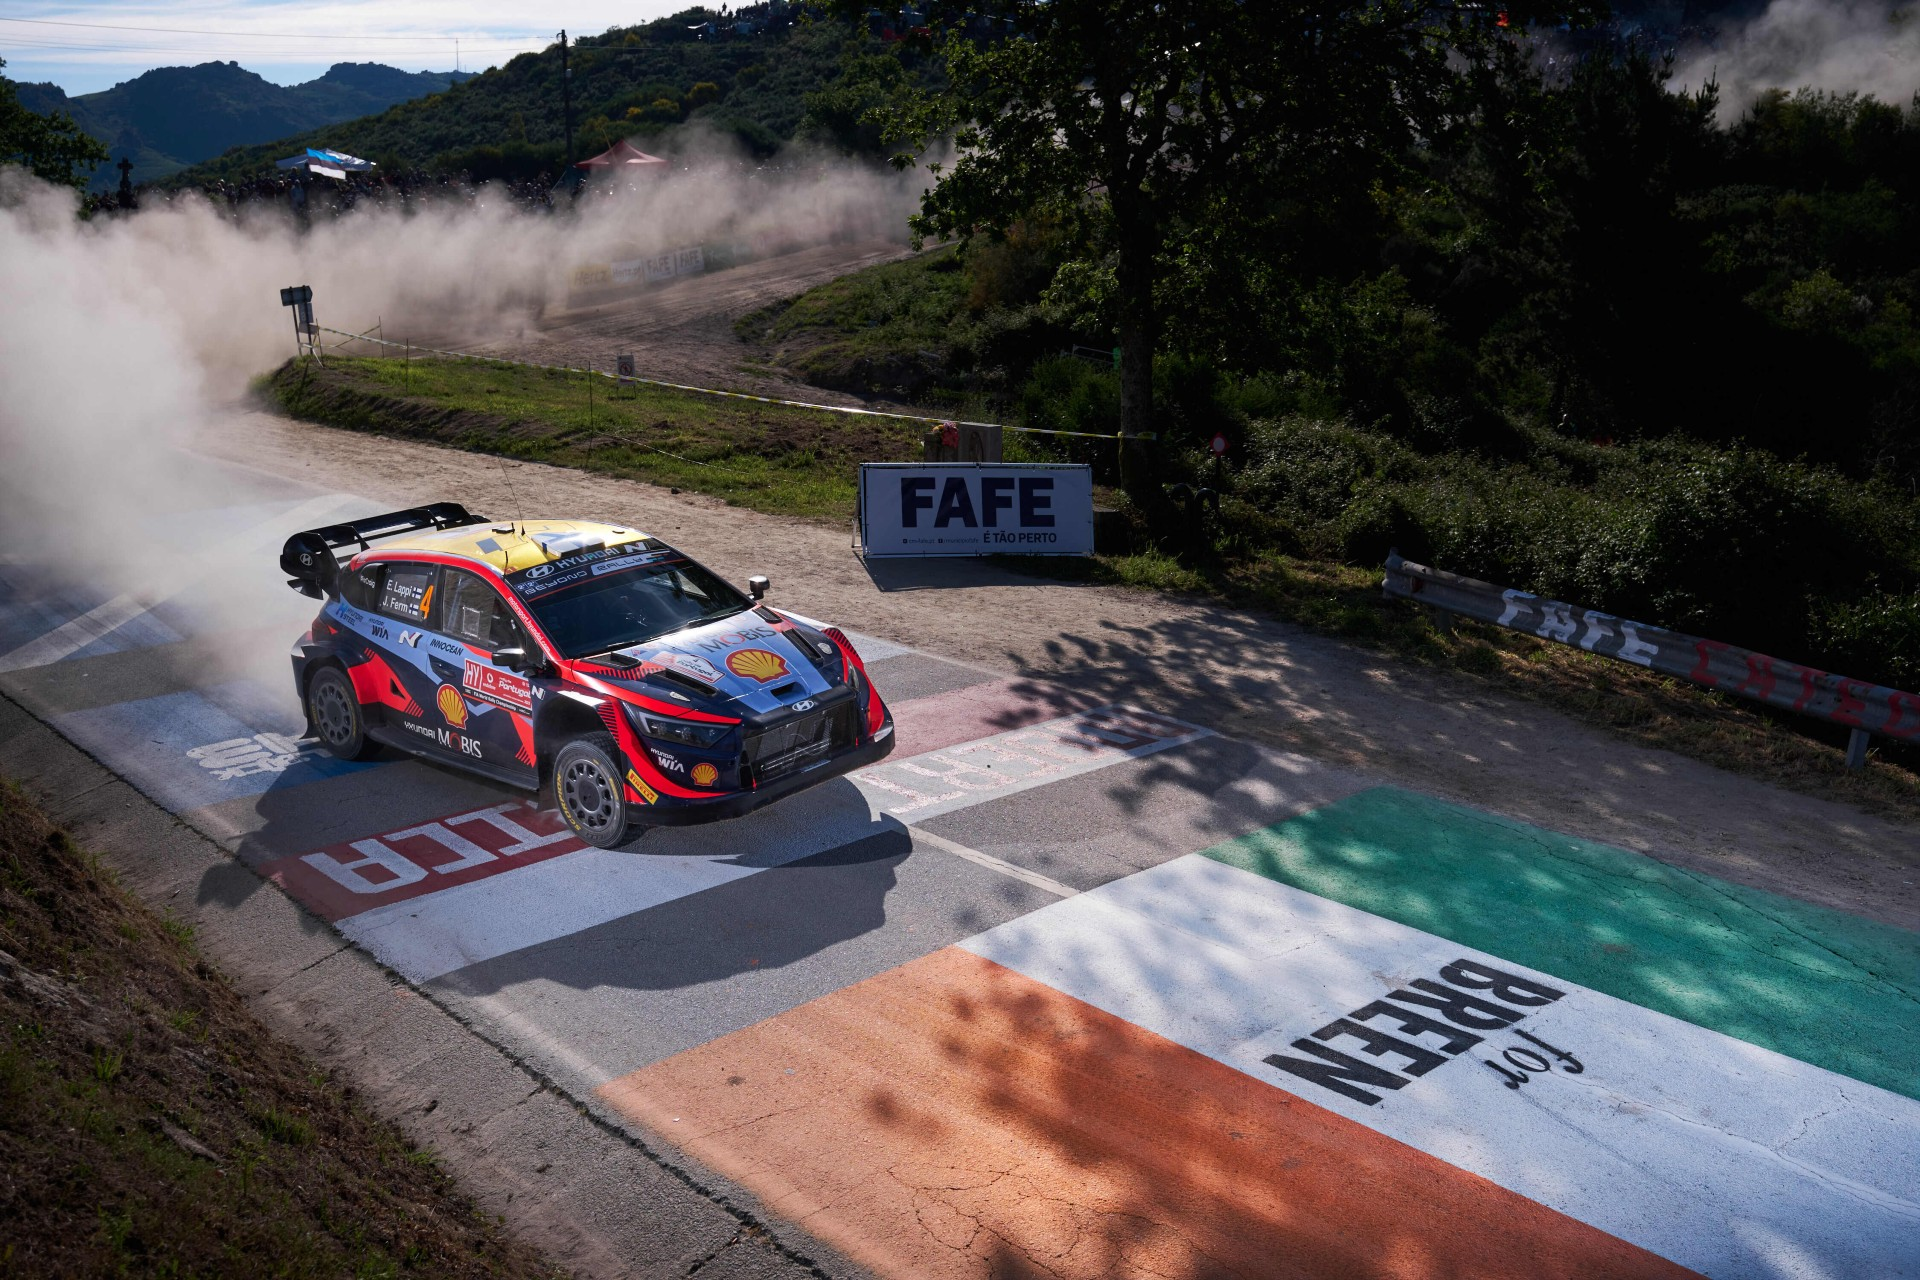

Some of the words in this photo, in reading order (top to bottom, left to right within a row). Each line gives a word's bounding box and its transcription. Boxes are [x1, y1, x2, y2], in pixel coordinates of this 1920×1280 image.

[901, 477, 1055, 528] FAFE
[983, 530, 991, 543] É
[993, 530, 1016, 543] TÃO
[1018, 532, 1057, 543] PERTO
[556, 547, 620, 569] HYUNDAI
[525, 570, 588, 595] BEYOND
[597, 557, 643, 572] RALLY
[386, 579, 393, 591] E.
[394, 581, 412, 598] Lappi
[382, 595, 389, 607] J.
[390, 597, 408, 613] Ferm
[420, 584, 434, 619] 4
[343, 613, 355, 626] STEEL
[1497, 588, 1669, 667] FAFE
[371, 624, 389, 640] WIA
[698, 626, 777, 653] MOBIS
[430, 638, 464, 656] INNOCEAN
[465, 662, 480, 687] HY
[498, 680, 531, 699] Portugal
[404, 721, 435, 740] HYUNDAI
[438, 728, 482, 758] MOBIS
[650, 747, 675, 760] HYUNDAI
[658, 756, 685, 773] WIA
[629, 772, 655, 801] PIRELLI
[557, 772, 582, 831] SCORPION
[1262, 959, 1567, 1106] BREEN
[1485, 1029, 1585, 1090] for
